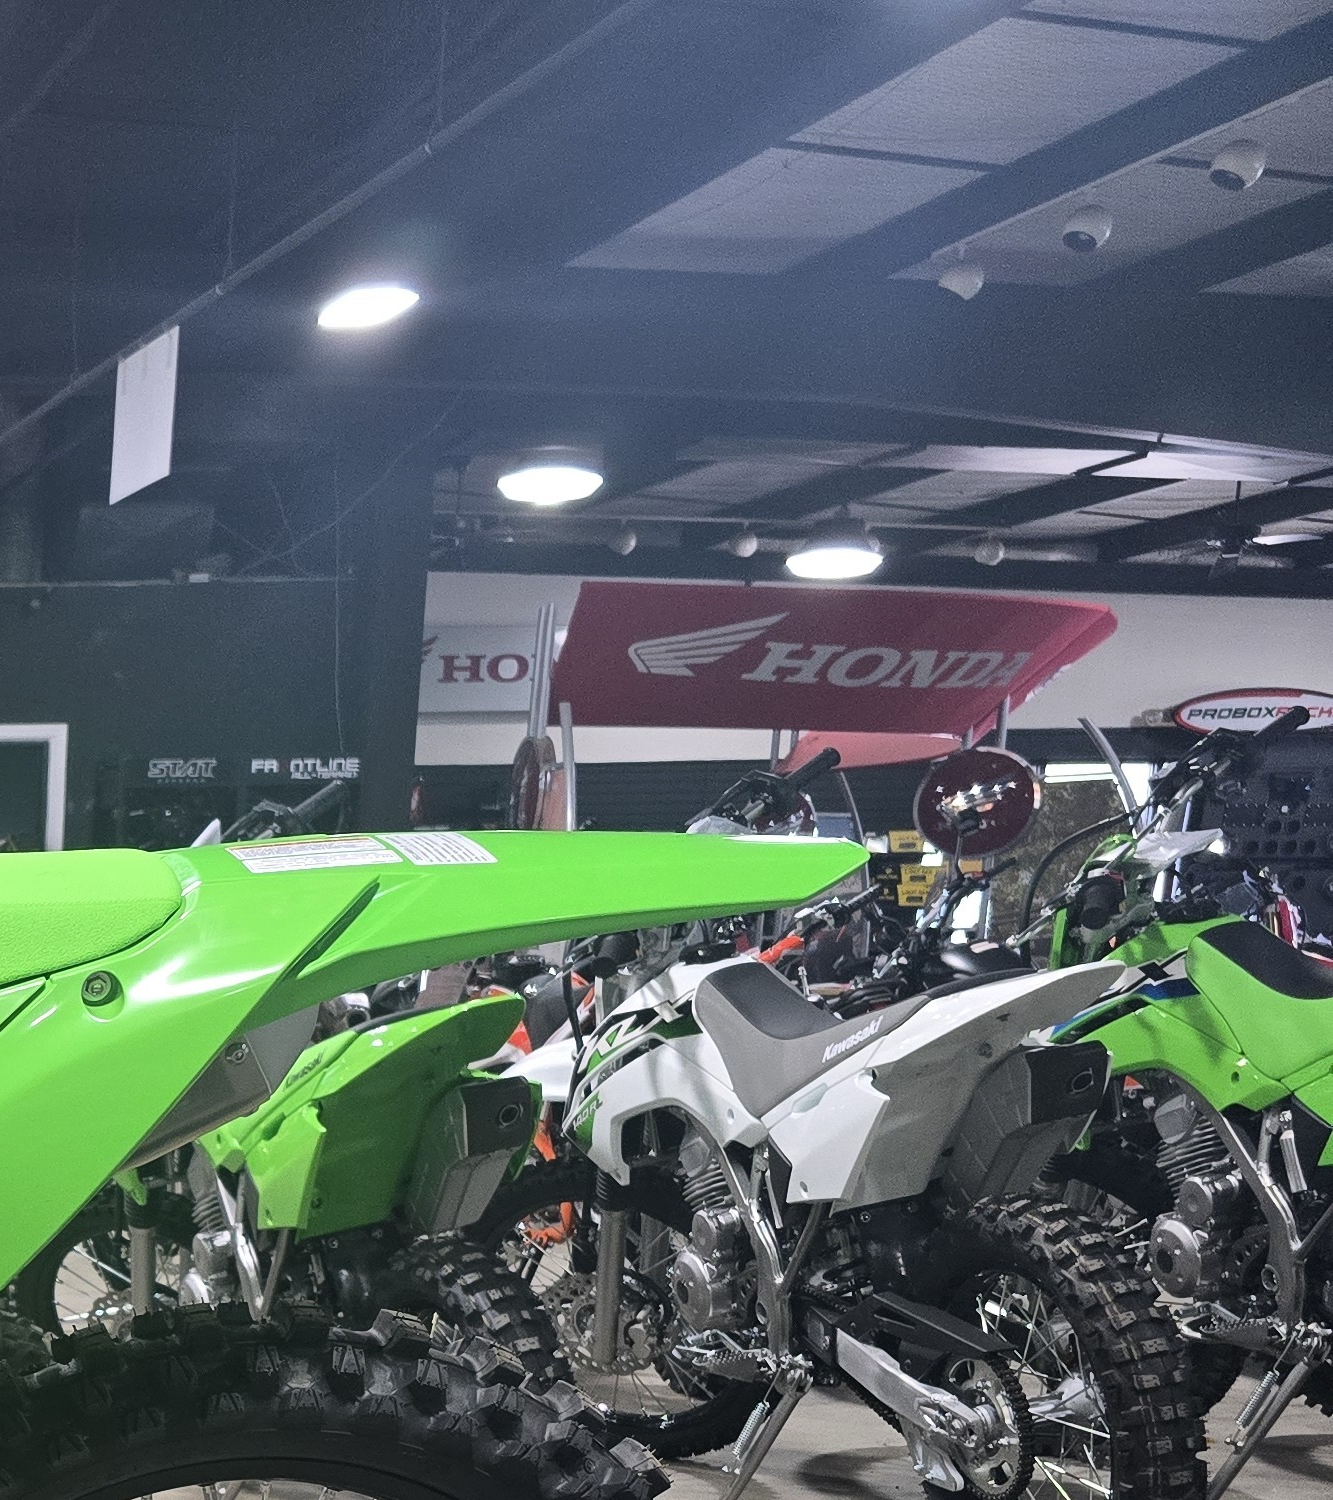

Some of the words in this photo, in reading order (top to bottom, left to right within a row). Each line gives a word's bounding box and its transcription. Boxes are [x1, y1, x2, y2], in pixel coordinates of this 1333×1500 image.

[437, 654, 532, 684] HO
[741, 642, 1032, 690] HONDA
[821, 1015, 884, 1063] Kawasaki
